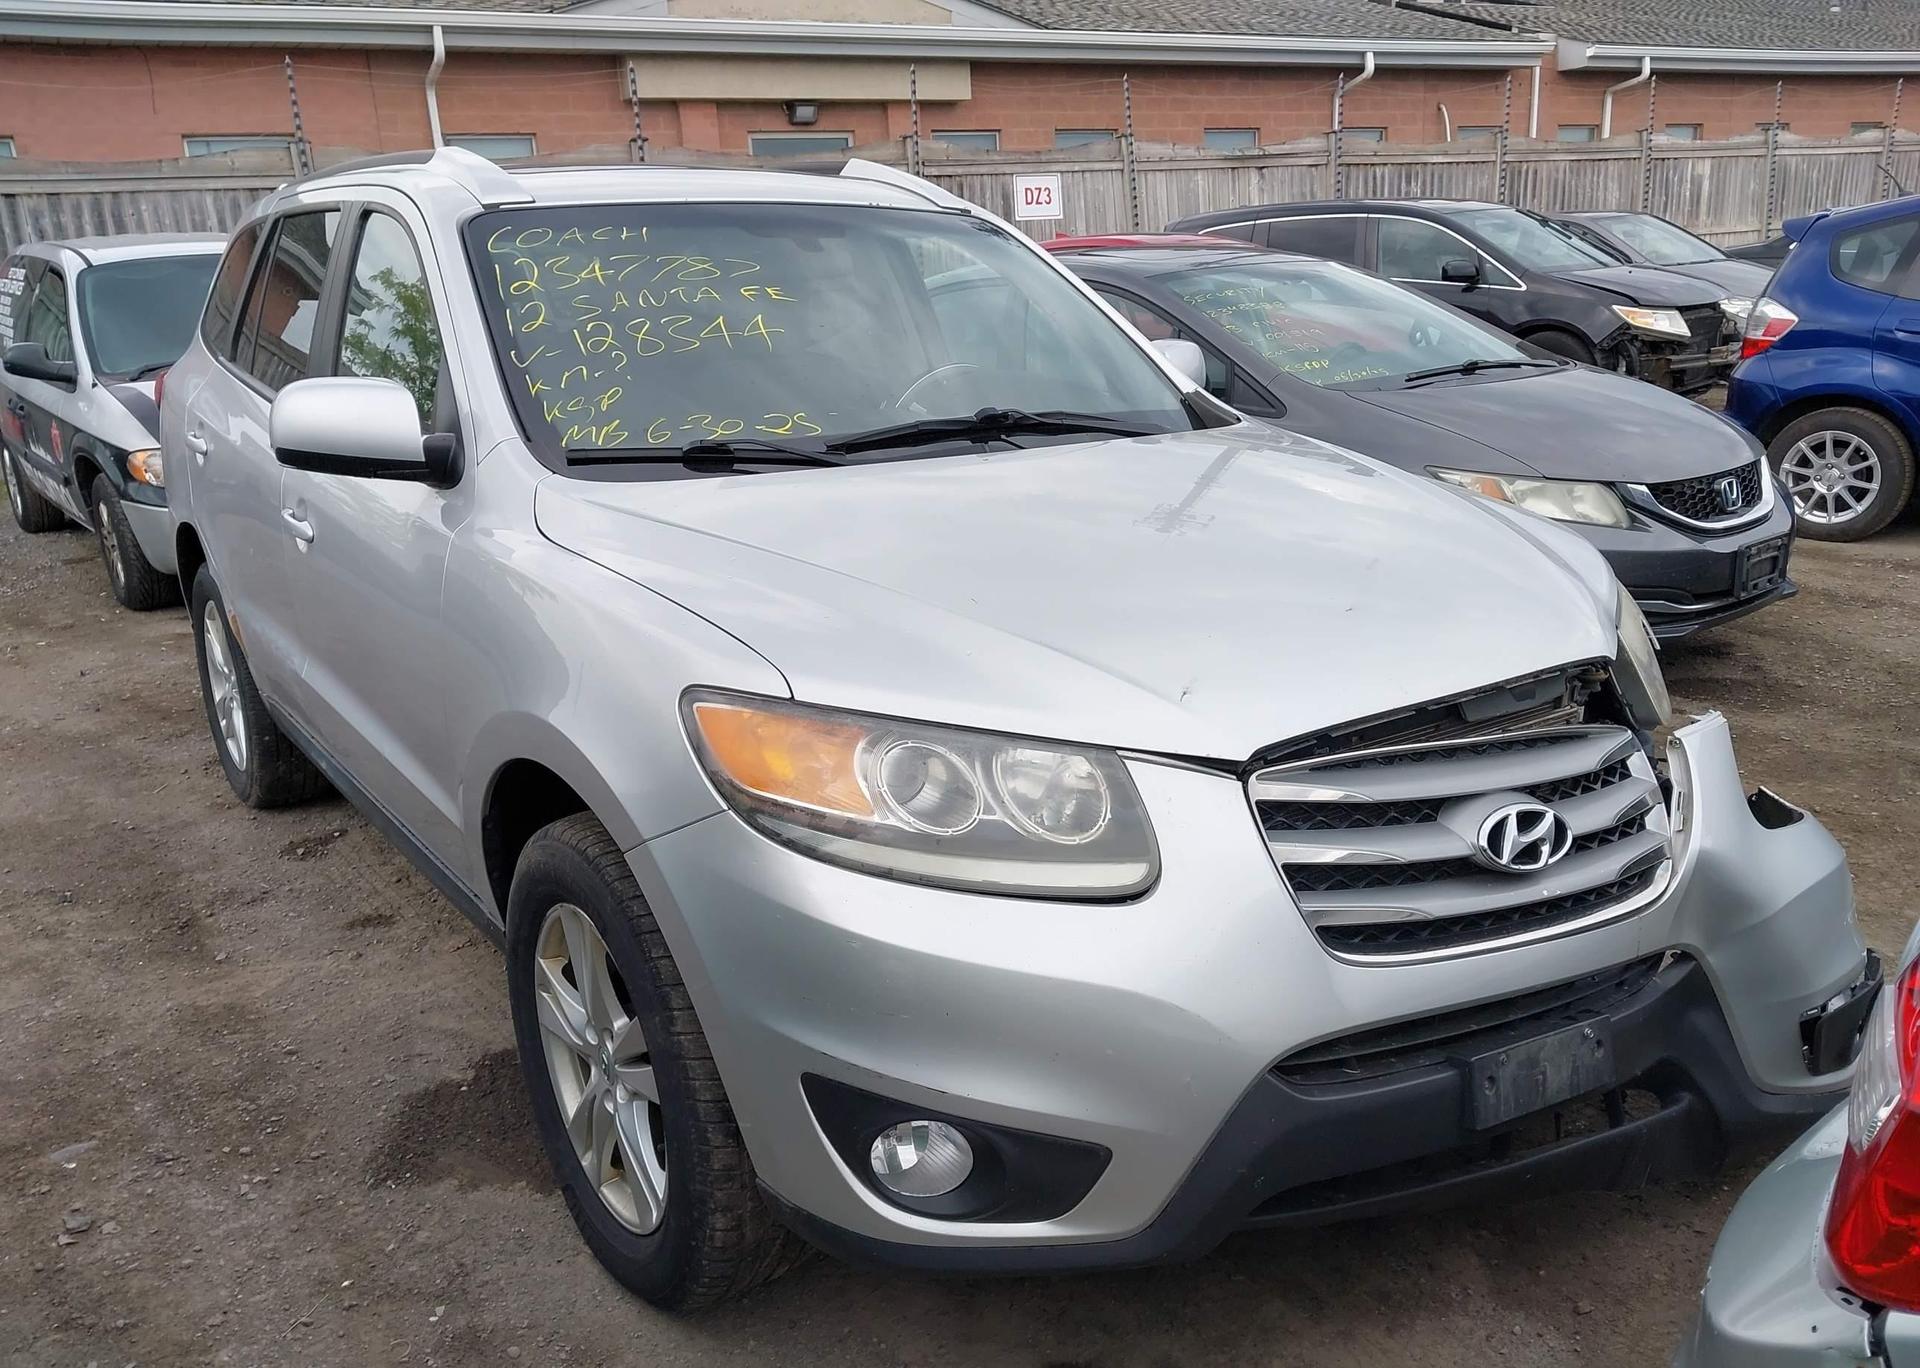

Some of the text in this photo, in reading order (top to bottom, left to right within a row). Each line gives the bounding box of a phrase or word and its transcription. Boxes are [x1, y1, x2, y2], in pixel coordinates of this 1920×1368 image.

[1024, 187, 1052, 205] DZ3
[488, 226, 648, 253] COACH
[507, 286, 798, 337] 12 SANTA FE
[563, 419, 629, 447] MB
